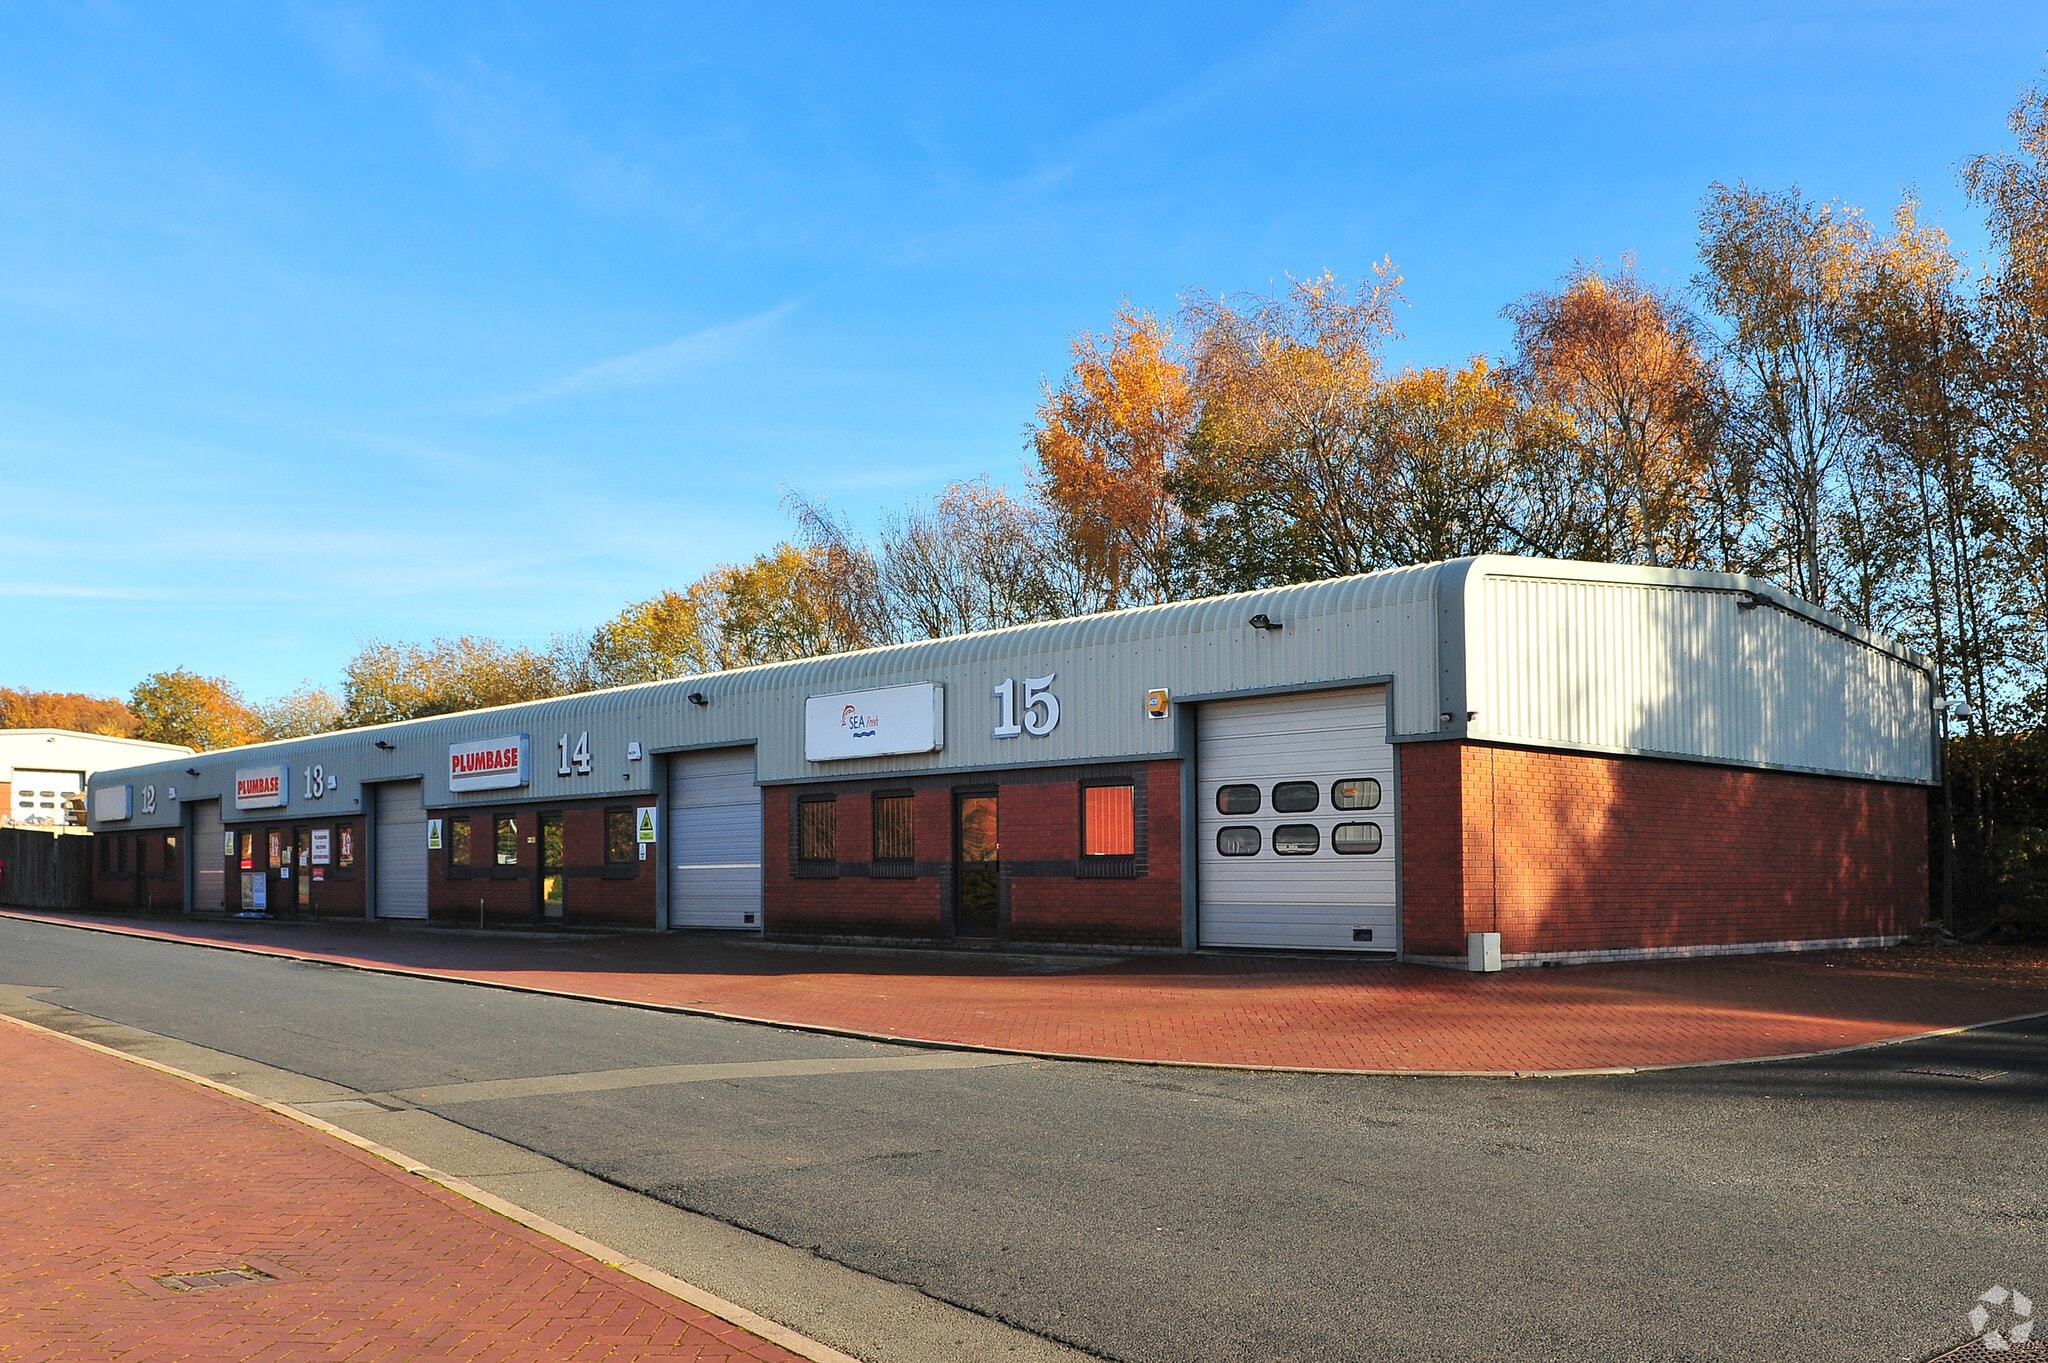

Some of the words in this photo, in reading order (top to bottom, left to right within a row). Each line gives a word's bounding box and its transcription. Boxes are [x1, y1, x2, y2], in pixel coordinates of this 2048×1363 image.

[993, 673, 1060, 738] 15
[849, 715, 865, 729] SEA
[452, 747, 518, 773] PLUMBASE
[559, 731, 591, 775] 14
[237, 776, 279, 795] PLUMBASE
[304, 764, 324, 799] 13
[141, 785, 156, 814] 12
